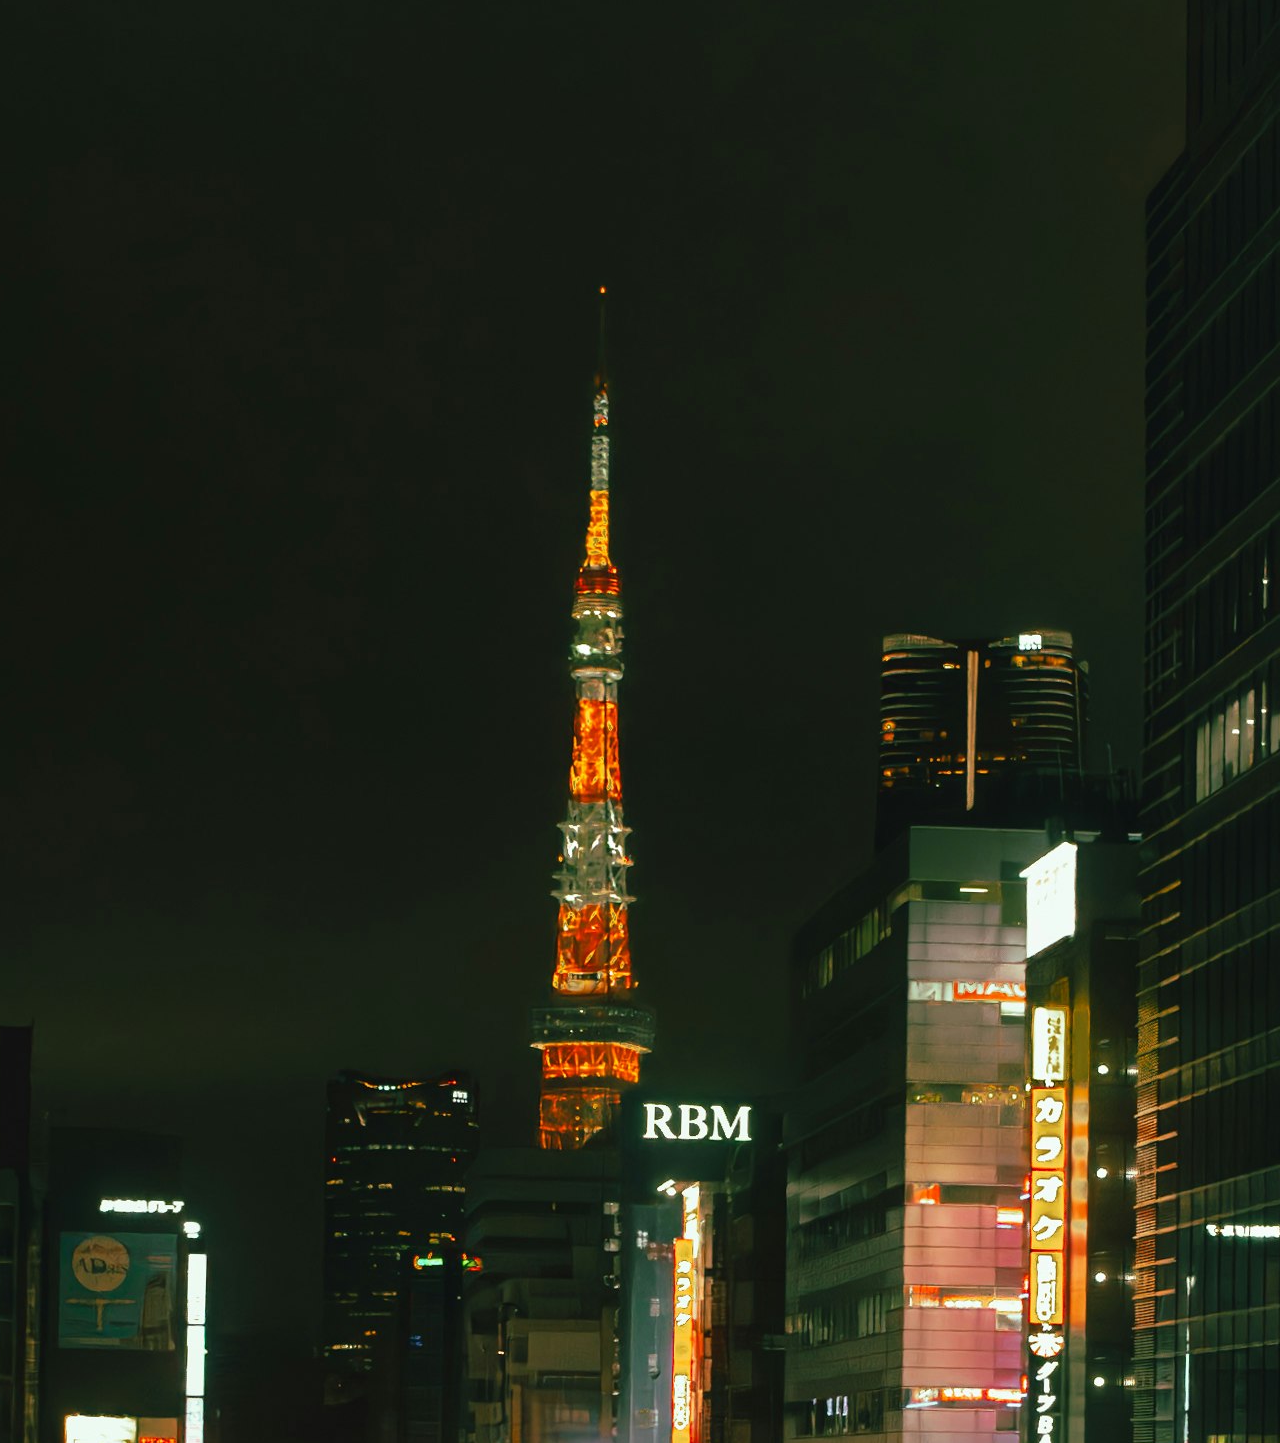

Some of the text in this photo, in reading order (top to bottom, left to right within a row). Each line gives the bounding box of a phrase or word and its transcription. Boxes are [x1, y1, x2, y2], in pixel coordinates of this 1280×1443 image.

[642, 1102, 753, 1142] RBM
[1032, 1097, 1064, 1241] カラオケ
